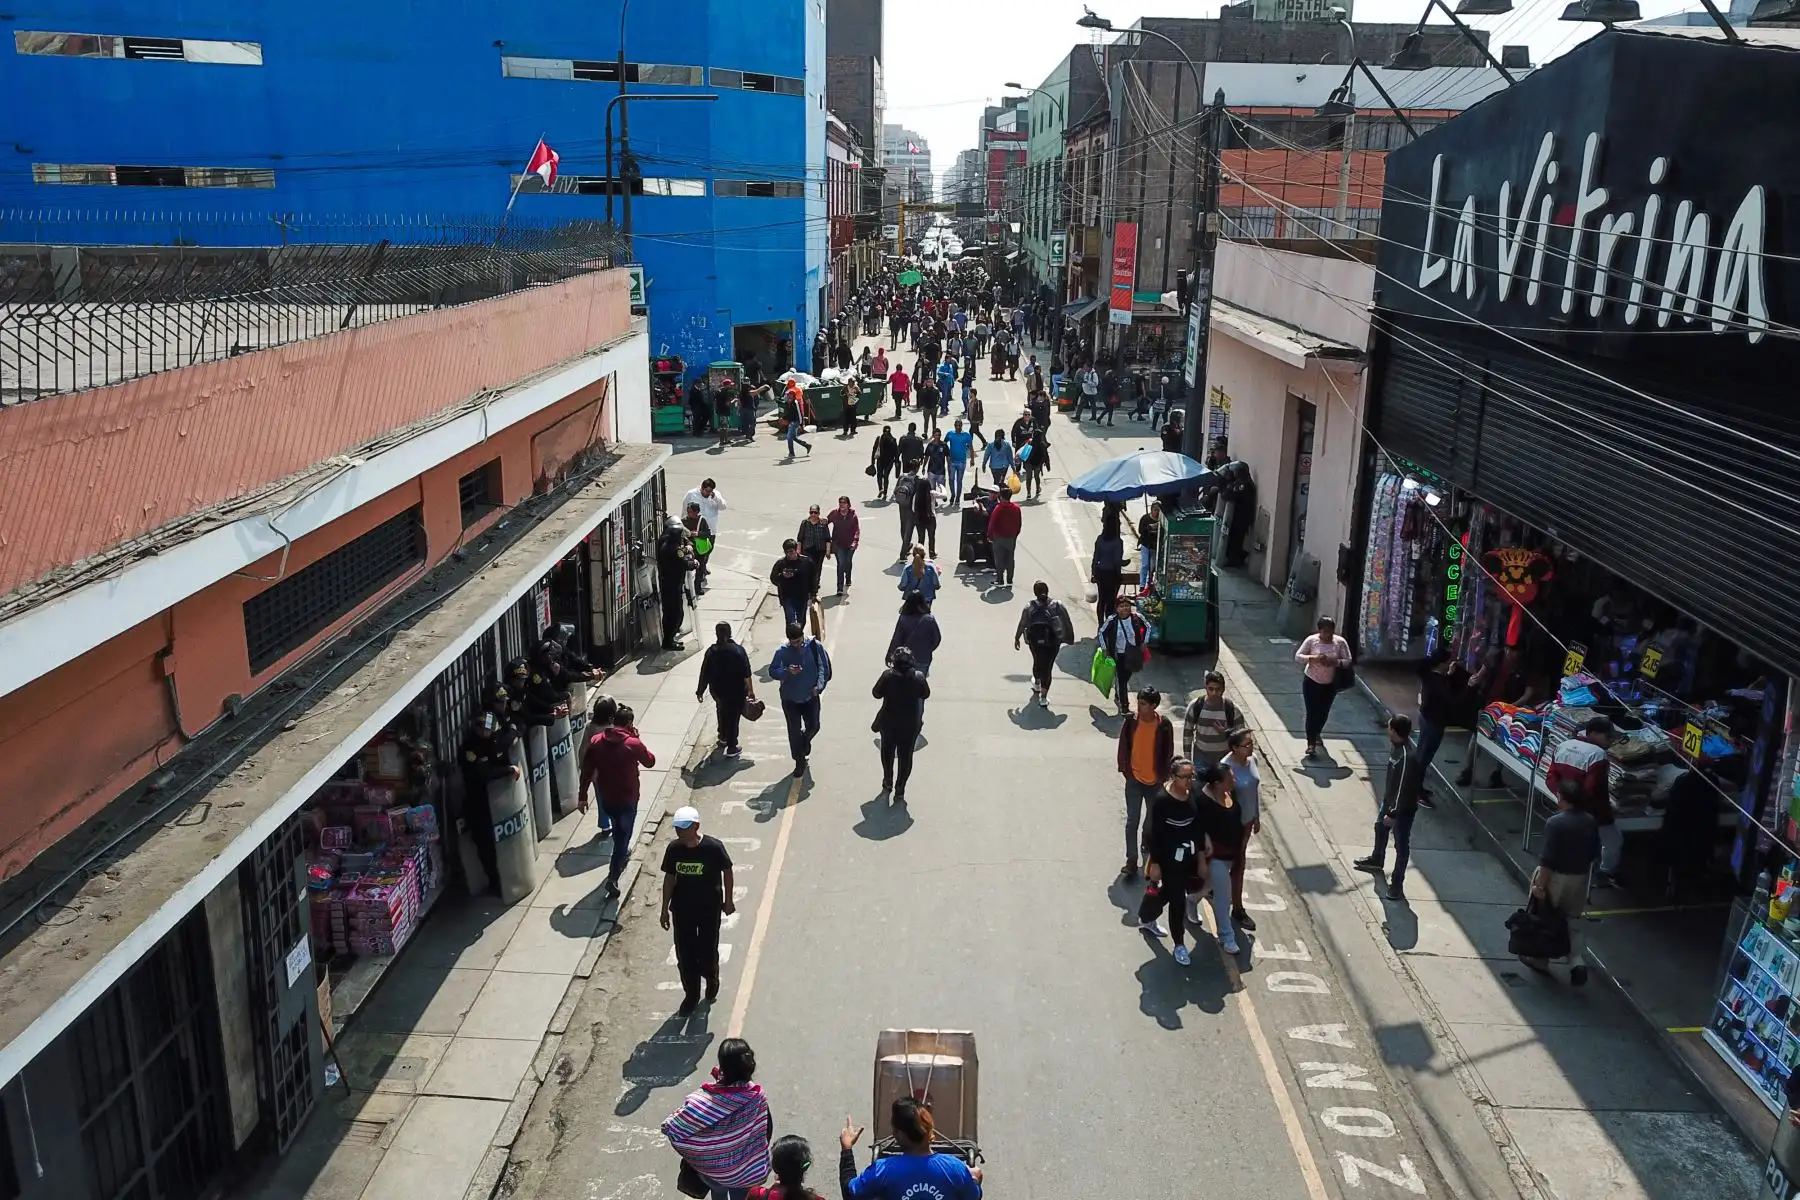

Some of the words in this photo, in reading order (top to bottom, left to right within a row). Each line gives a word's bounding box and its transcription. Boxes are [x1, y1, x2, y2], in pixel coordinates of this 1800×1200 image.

[1419, 153, 1477, 300] La
[1499, 131, 1770, 345] Vitrina
[1253, 937, 1331, 995] DE
[1286, 1022, 1427, 1195] ZONA
